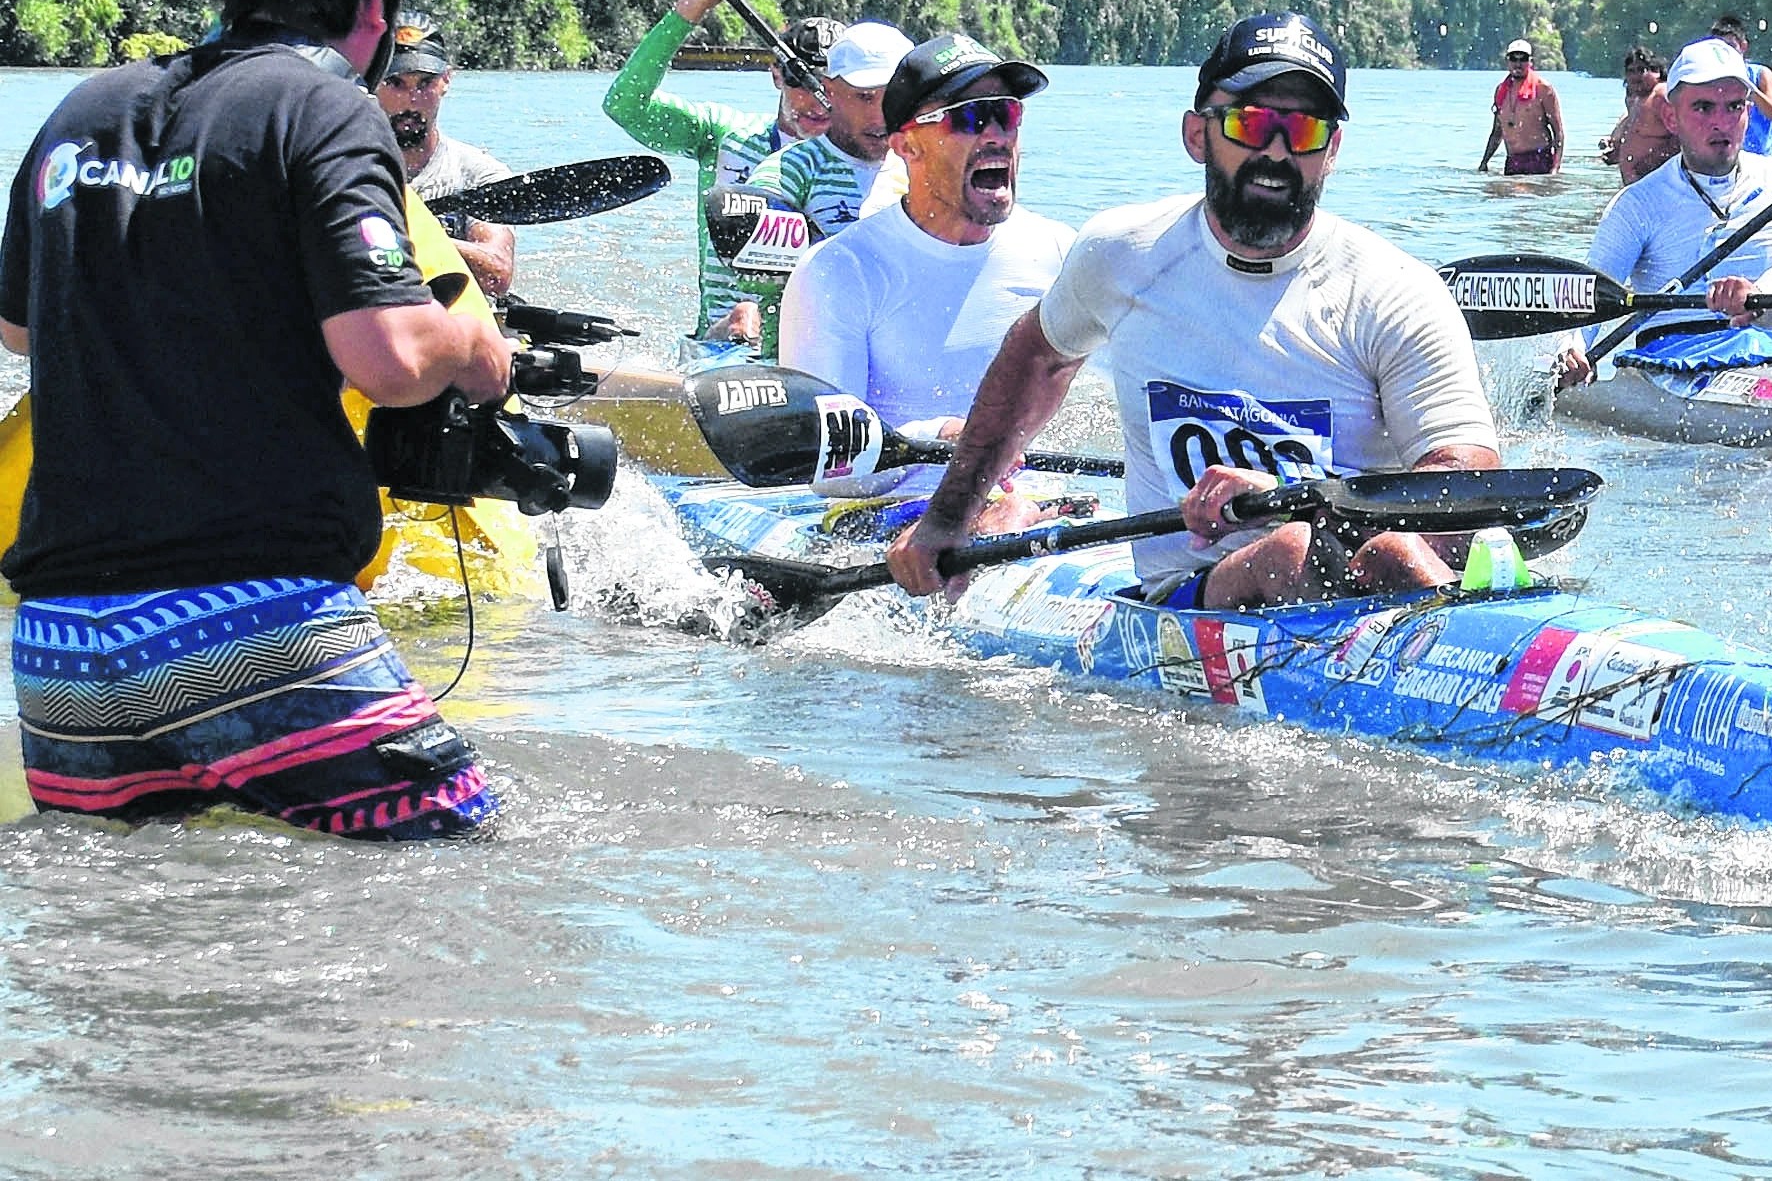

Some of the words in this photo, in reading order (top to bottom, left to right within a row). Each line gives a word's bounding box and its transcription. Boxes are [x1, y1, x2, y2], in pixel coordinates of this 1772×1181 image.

[368, 249, 404, 269] C10
[1456, 275, 1521, 308] CEMENTOS
[1524, 277, 1550, 309] DEL
[1553, 278, 1594, 310] VALLE
[1426, 643, 1503, 675] MECANICA
